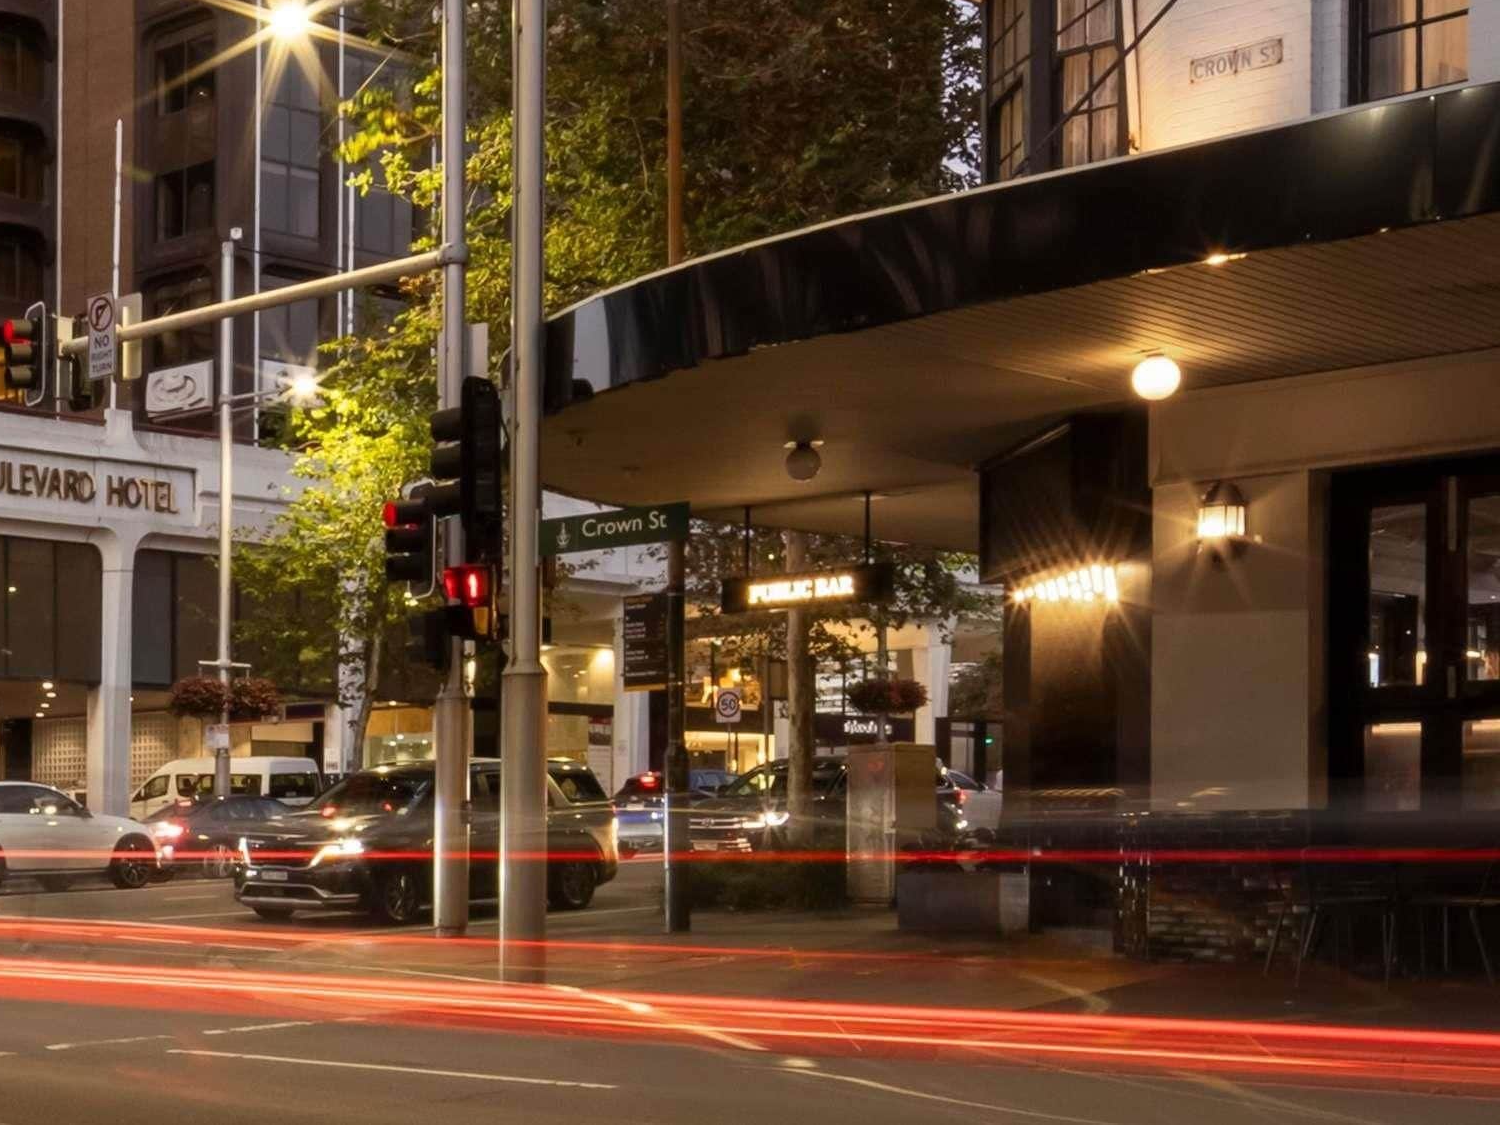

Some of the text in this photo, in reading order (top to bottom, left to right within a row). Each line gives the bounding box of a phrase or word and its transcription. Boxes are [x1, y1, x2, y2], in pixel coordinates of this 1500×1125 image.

[1193, 49, 1252, 79] CROWN
[94, 335, 110, 349] NO
[106, 475, 179, 514] HOTEL
[581, 510, 667, 537] Crown St
[814, 575, 855, 598] BAR
[720, 697, 736, 711] 50
